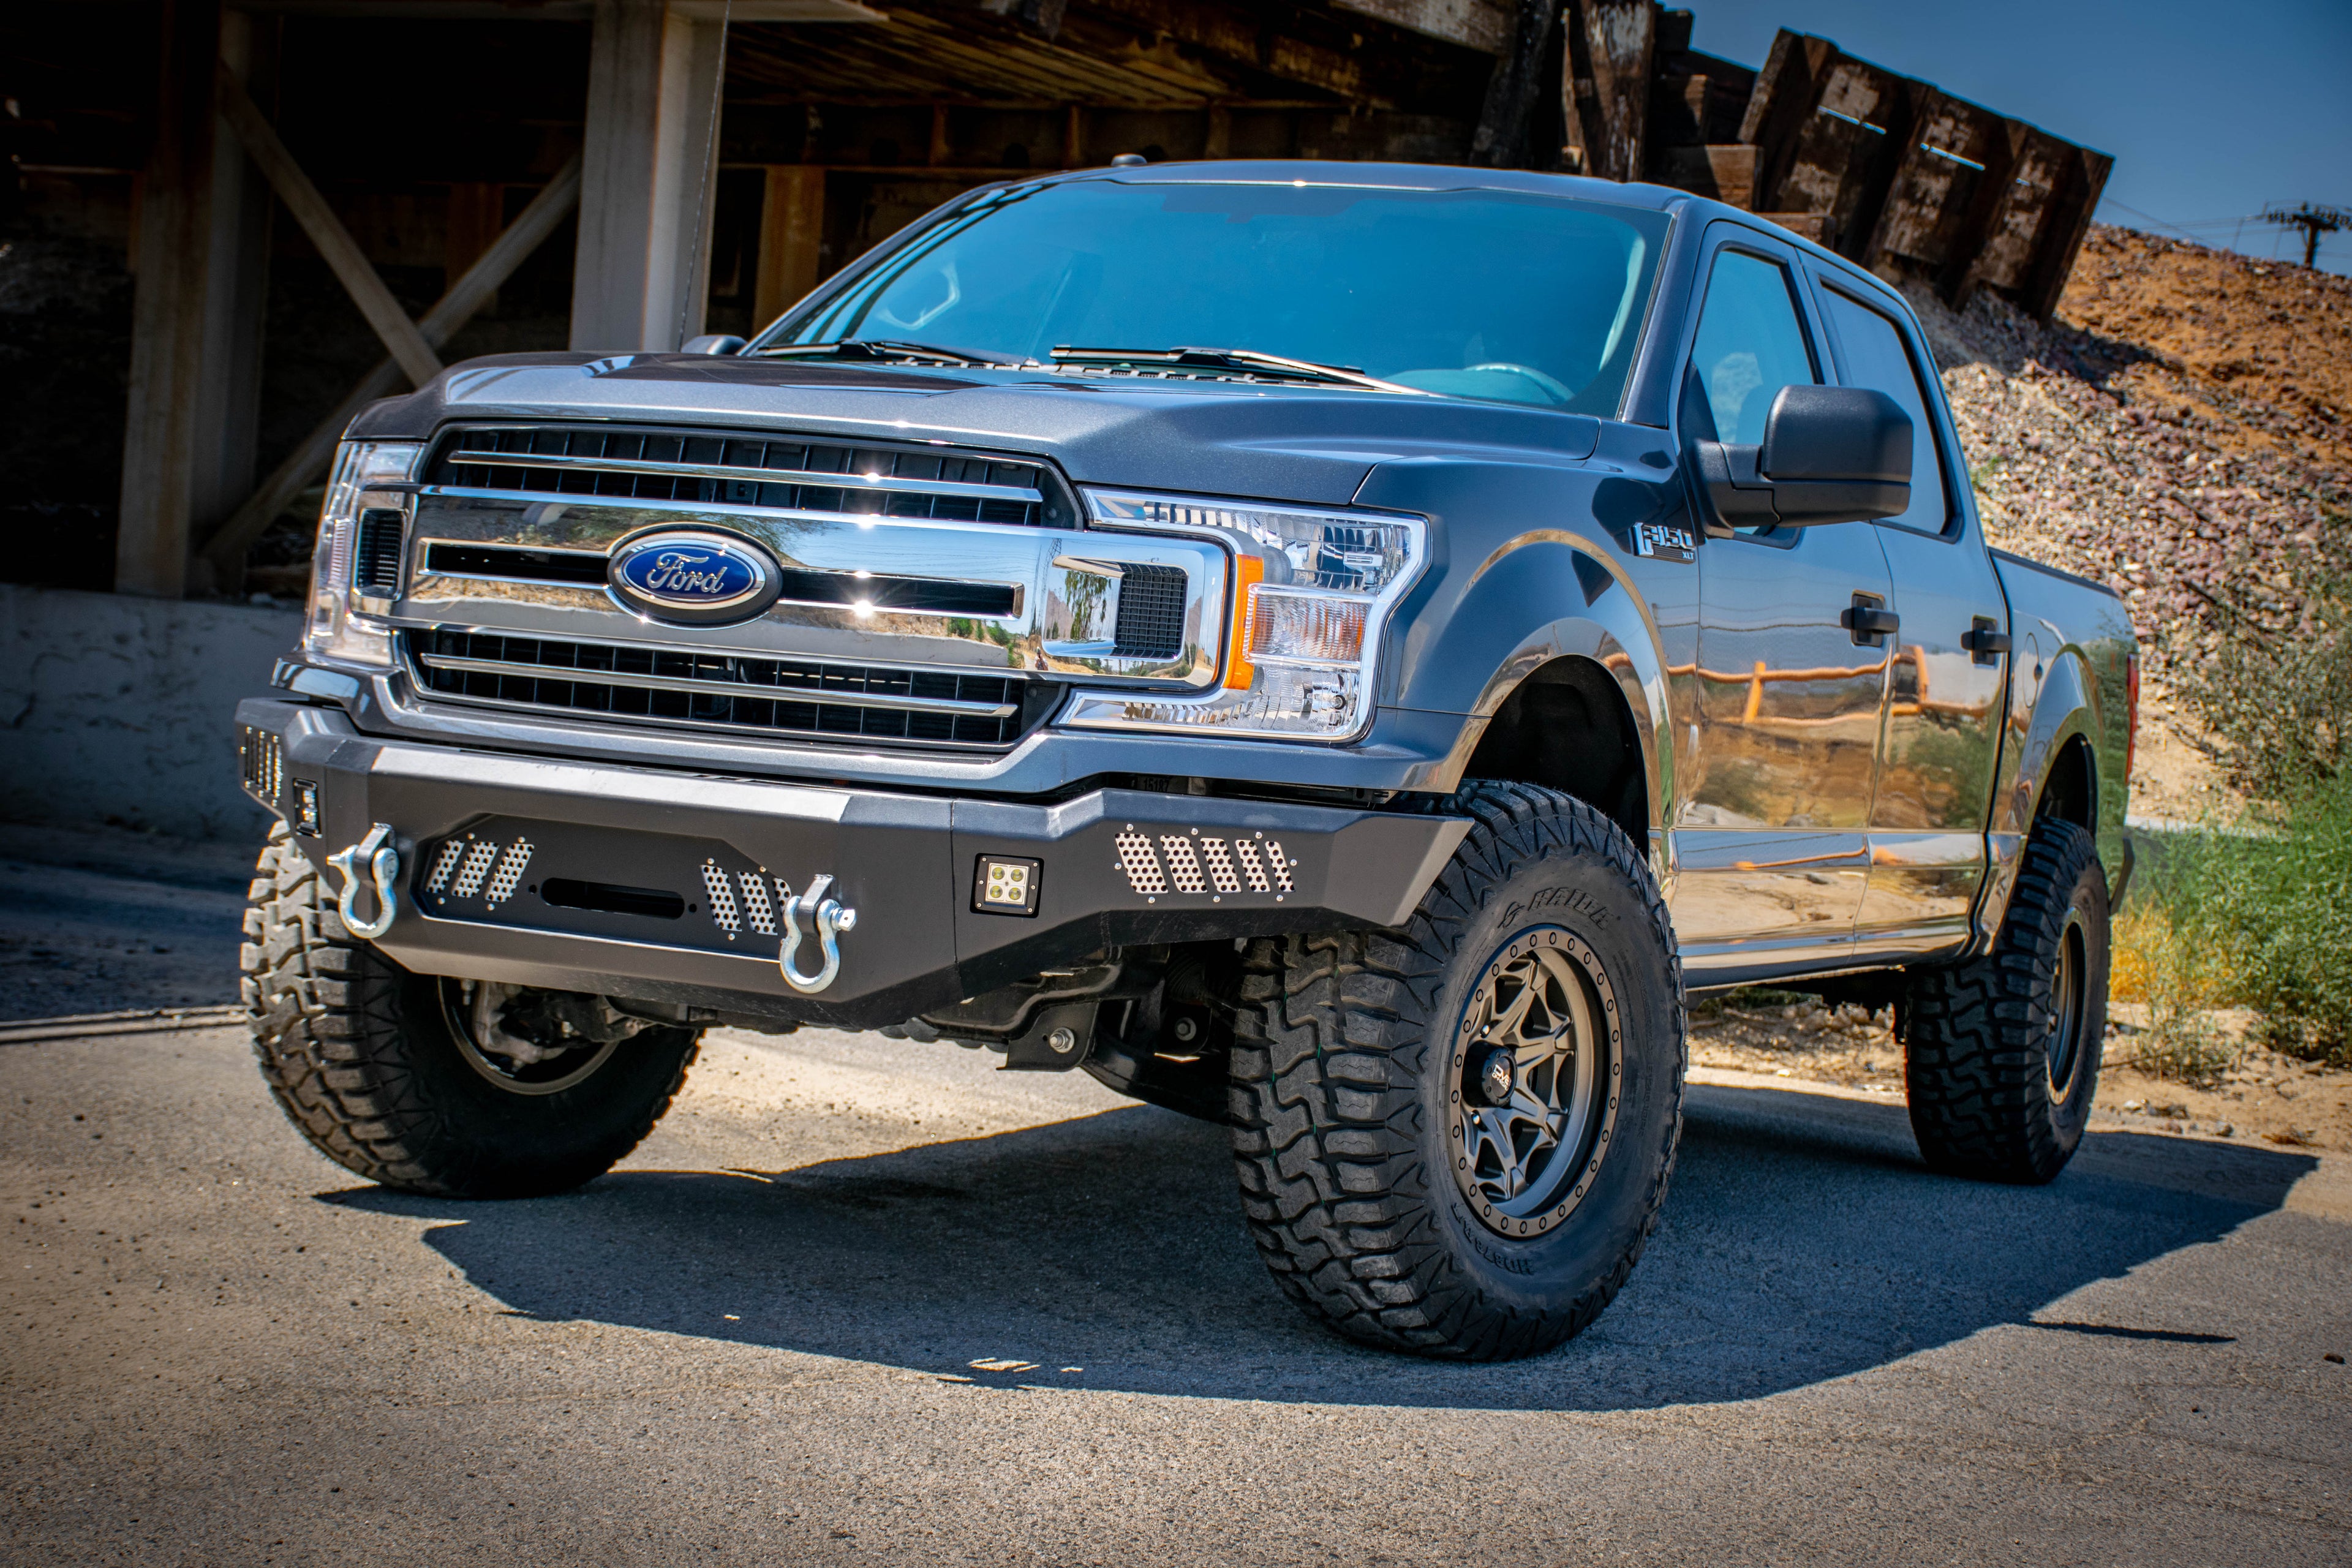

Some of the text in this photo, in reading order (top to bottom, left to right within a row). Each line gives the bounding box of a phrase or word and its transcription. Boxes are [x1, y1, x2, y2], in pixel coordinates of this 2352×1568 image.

[647, 552, 728, 594] Ford
[1682, 551, 1694, 560] XLT
[1528, 887, 1615, 931] HAIDA
